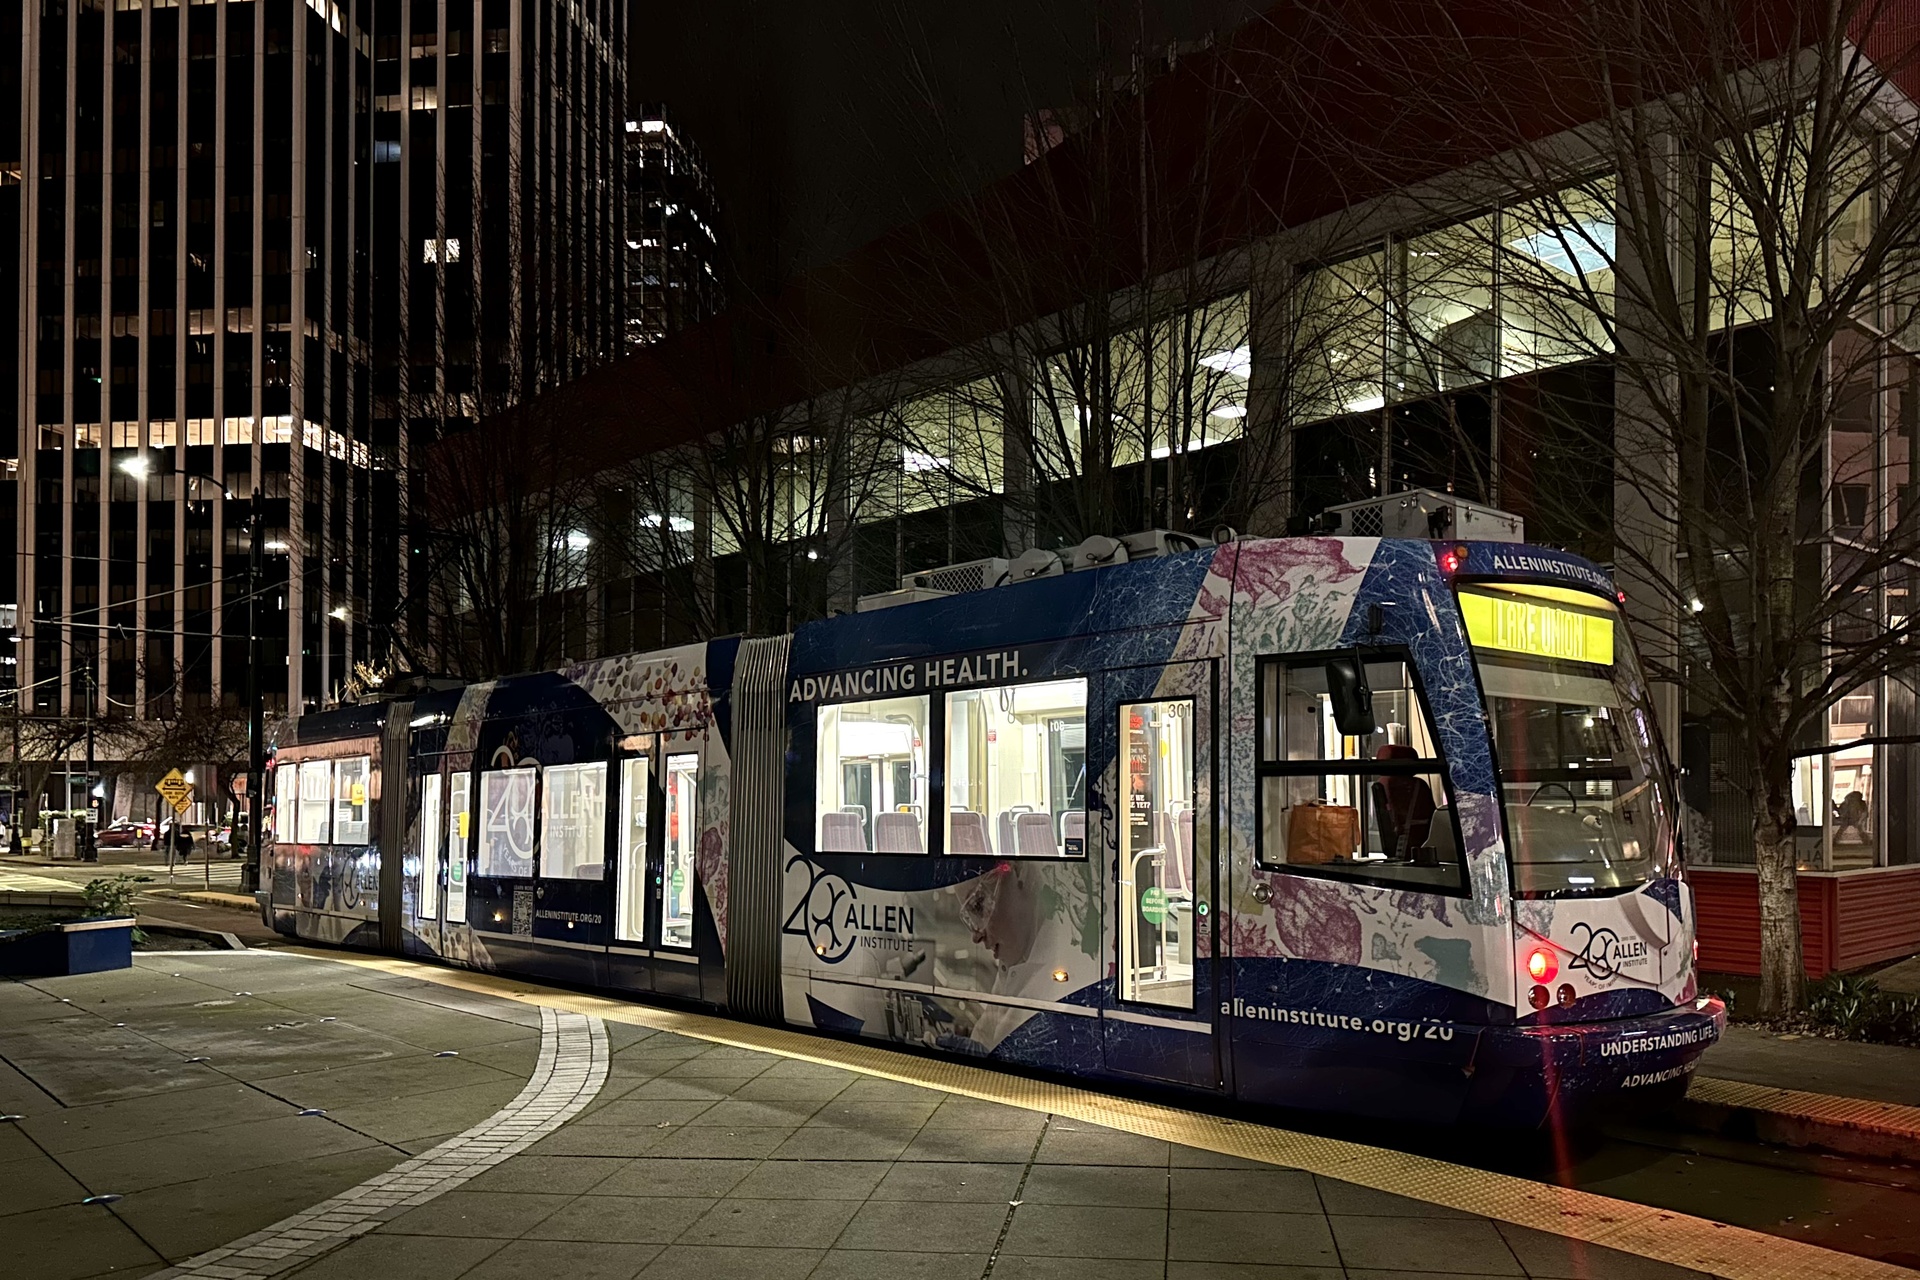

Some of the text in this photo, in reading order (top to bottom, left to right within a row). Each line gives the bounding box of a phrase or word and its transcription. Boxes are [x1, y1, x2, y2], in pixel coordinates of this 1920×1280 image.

[1497, 600, 1583, 658] LAKE UNION
[789, 651, 1028, 702] ADVANCING HEALTH.
[1168, 703, 1191, 718] 301
[536, 909, 602, 924] ALLENINSTITUTE.ORG/20
[844, 903, 914, 934] ALLEN
[860, 936, 914, 952] INSTITUTE
[1613, 941, 1648, 960] ALLEN
[1622, 958, 1648, 968] INSTITUTE
[1601, 1030, 1698, 1057] UNDERSTANDING
[1621, 1065, 1683, 1088] ADVANCING
